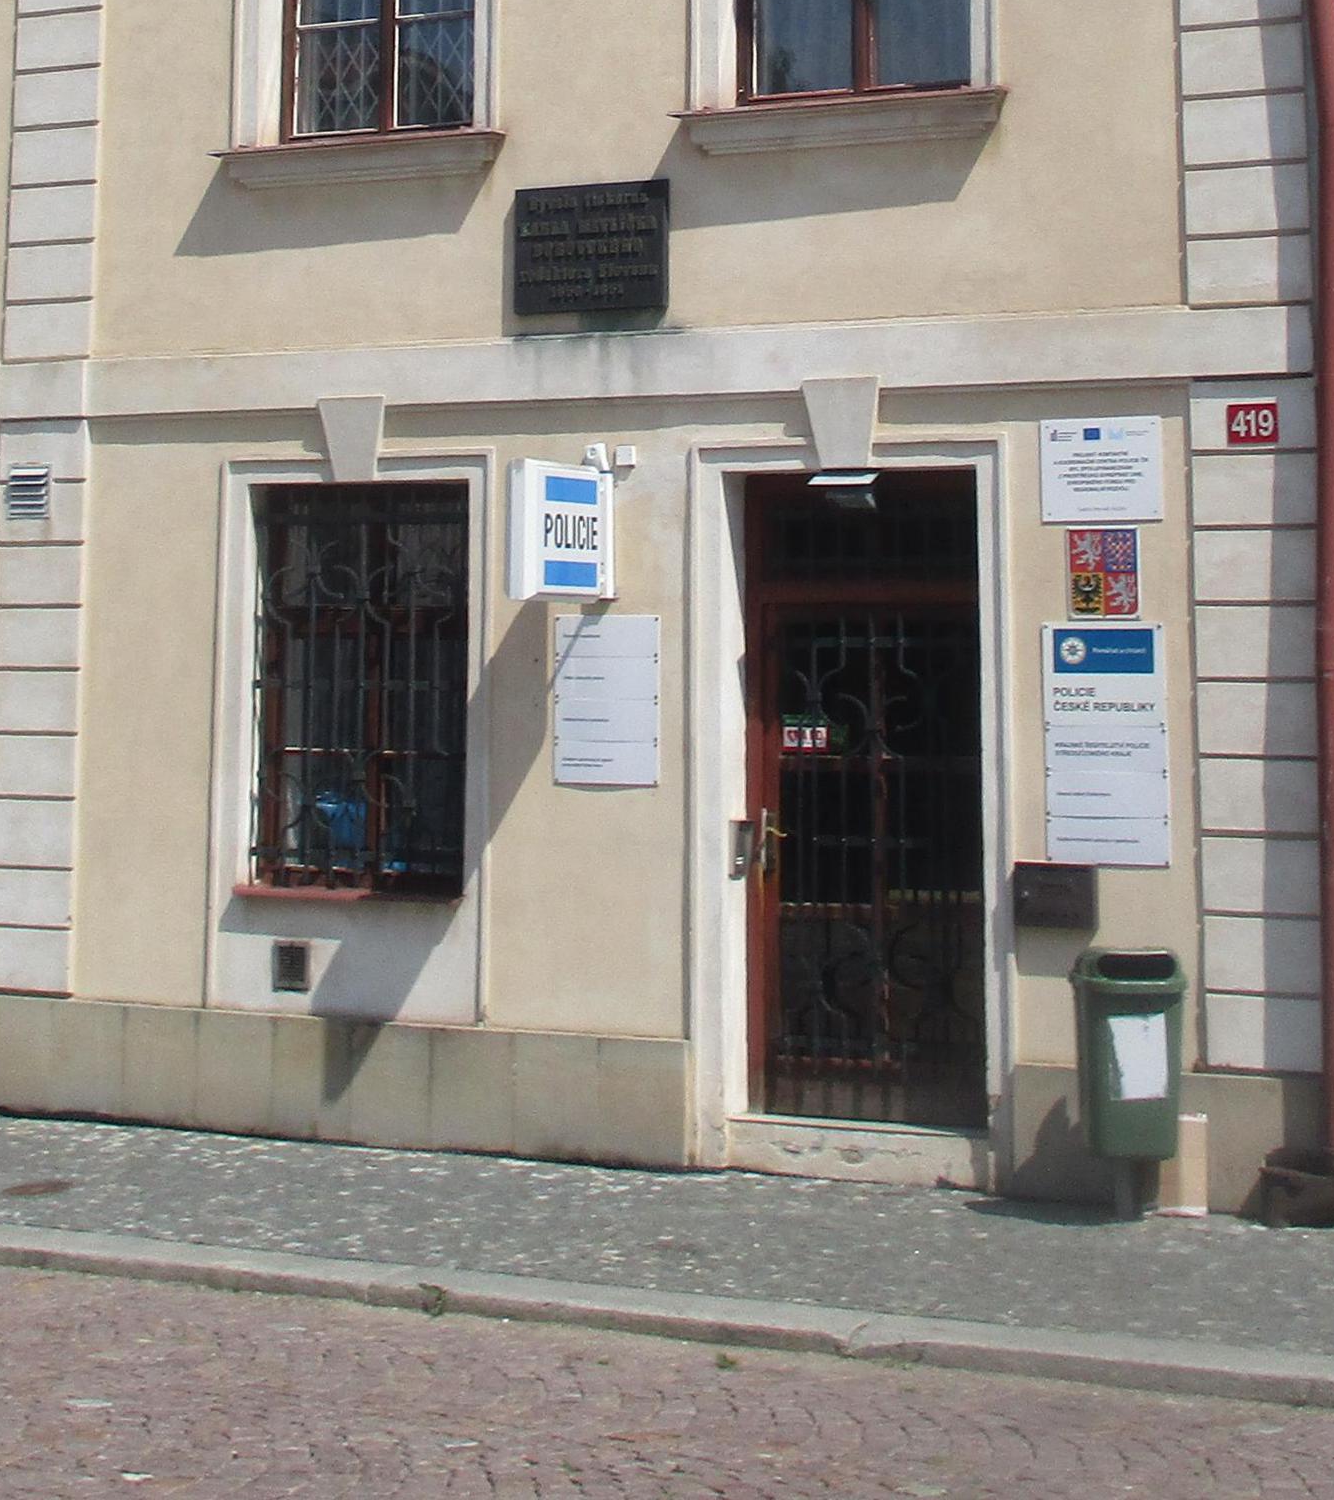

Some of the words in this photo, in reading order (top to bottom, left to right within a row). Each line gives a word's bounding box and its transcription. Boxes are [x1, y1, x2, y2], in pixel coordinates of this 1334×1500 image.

[1231, 409, 1274, 437] 419
[544, 513, 598, 550] POLICIE
[1053, 687, 1096, 697] POLICIE
[1053, 700, 1090, 712] ČESKÉ
[1093, 702, 1156, 712] REPUBLIKY
